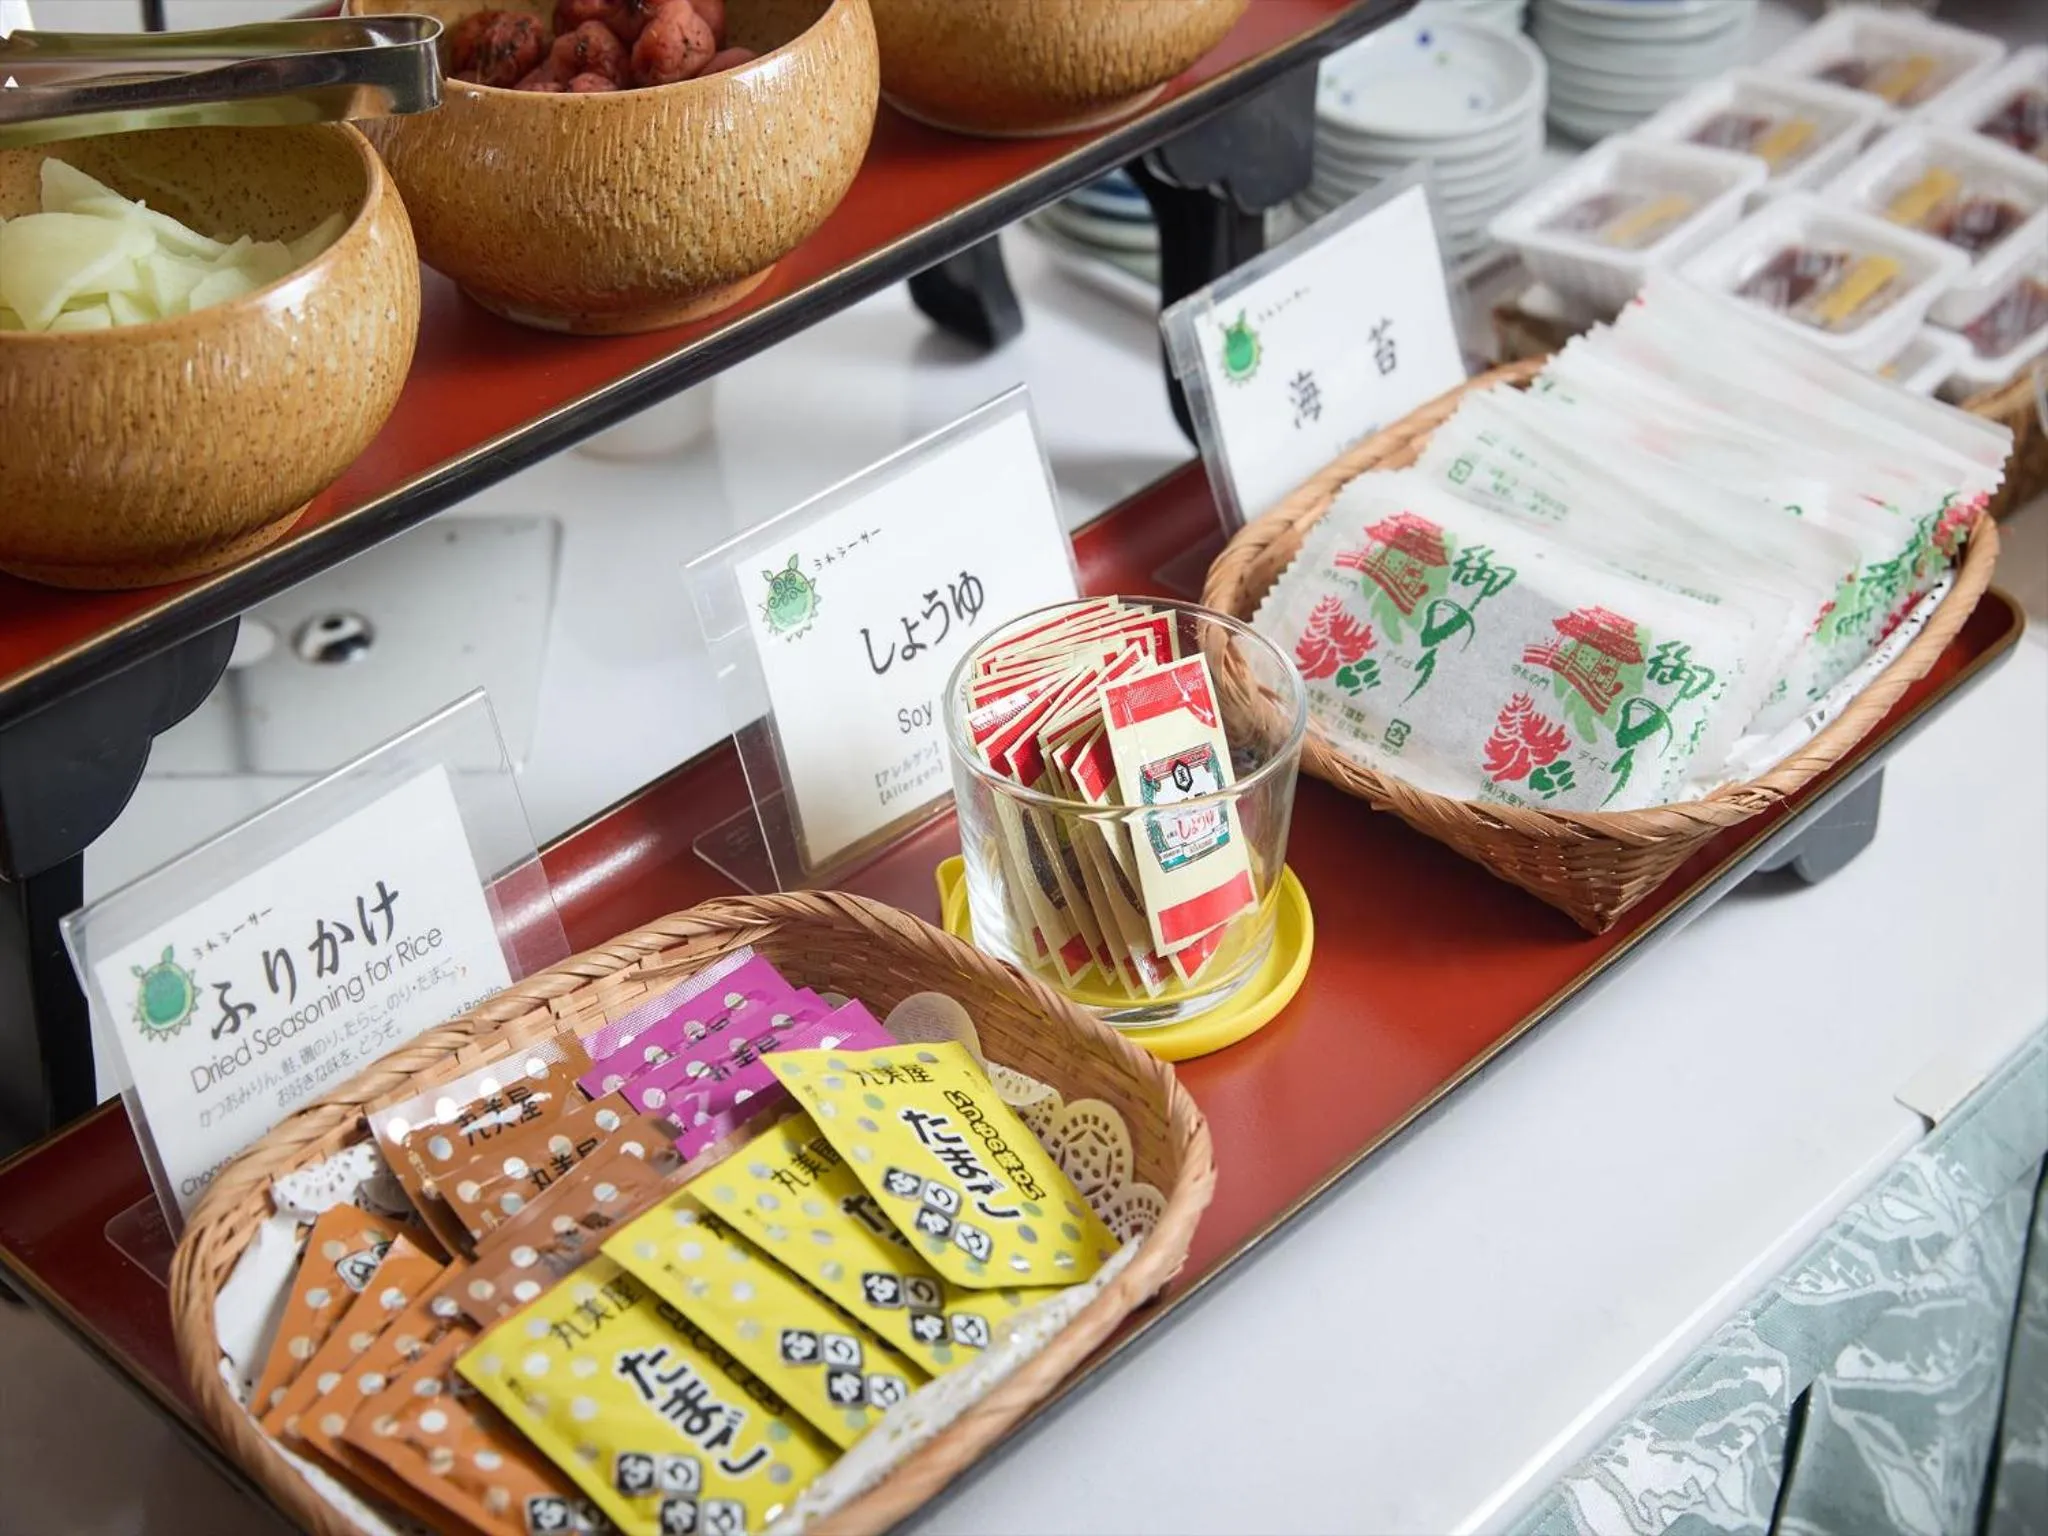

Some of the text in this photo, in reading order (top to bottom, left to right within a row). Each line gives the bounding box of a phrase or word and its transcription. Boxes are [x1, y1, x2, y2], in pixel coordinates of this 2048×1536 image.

[861, 570, 984, 674] しょうゆ
[897, 700, 933, 734] Soy
[190, 928, 443, 1094] Dried Seasoning for Rice
[211, 880, 399, 1039] ふりかけ
[849, 1064, 935, 1086] 丸美屋
[899, 1108, 1020, 1220] たまご
[618, 1349, 767, 1474] たまご
